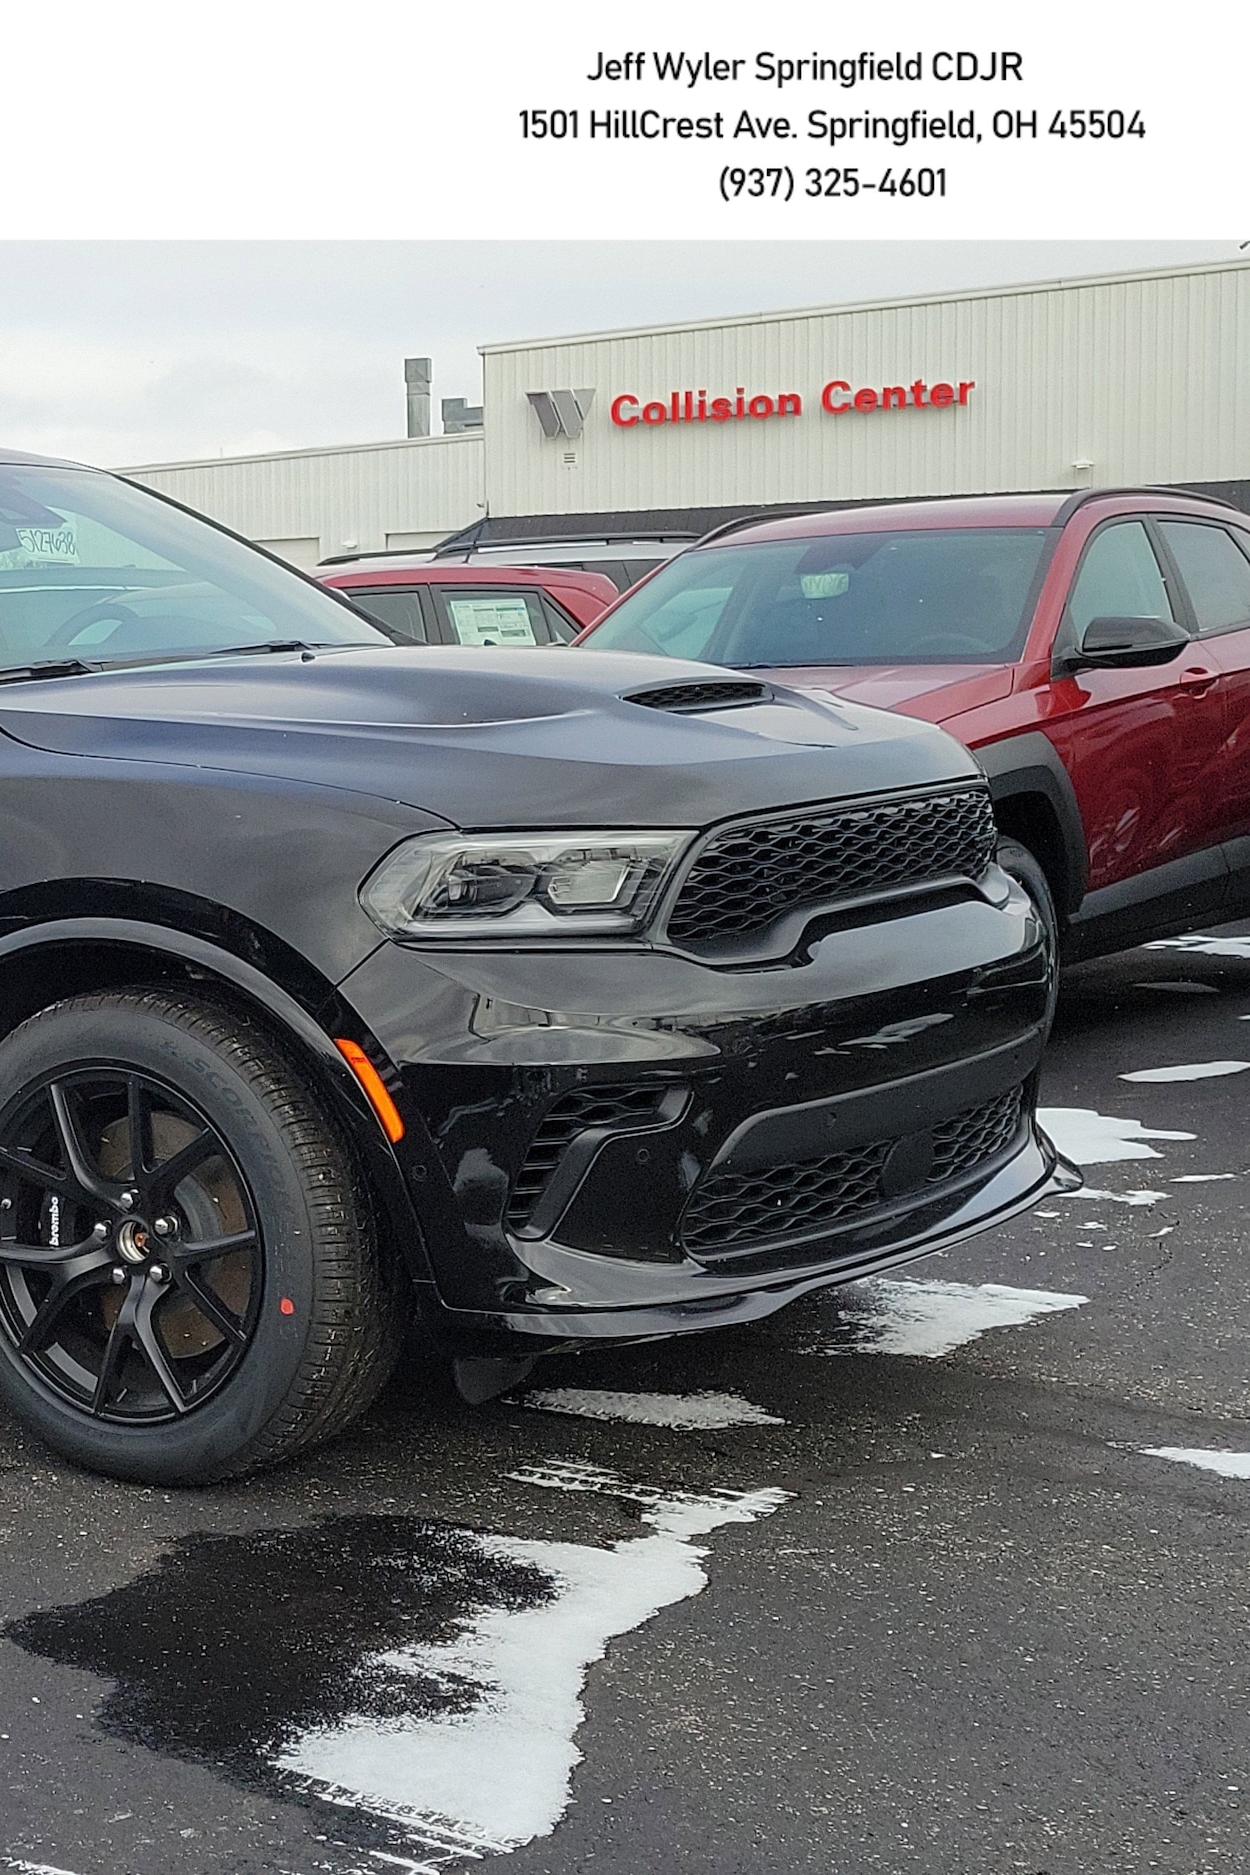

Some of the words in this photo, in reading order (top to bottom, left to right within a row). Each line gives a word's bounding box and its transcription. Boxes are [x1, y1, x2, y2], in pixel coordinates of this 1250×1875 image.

[610, 387, 803, 428] Collision
[821, 379, 976, 415] Center
[48, 1195, 60, 1247] brembo
